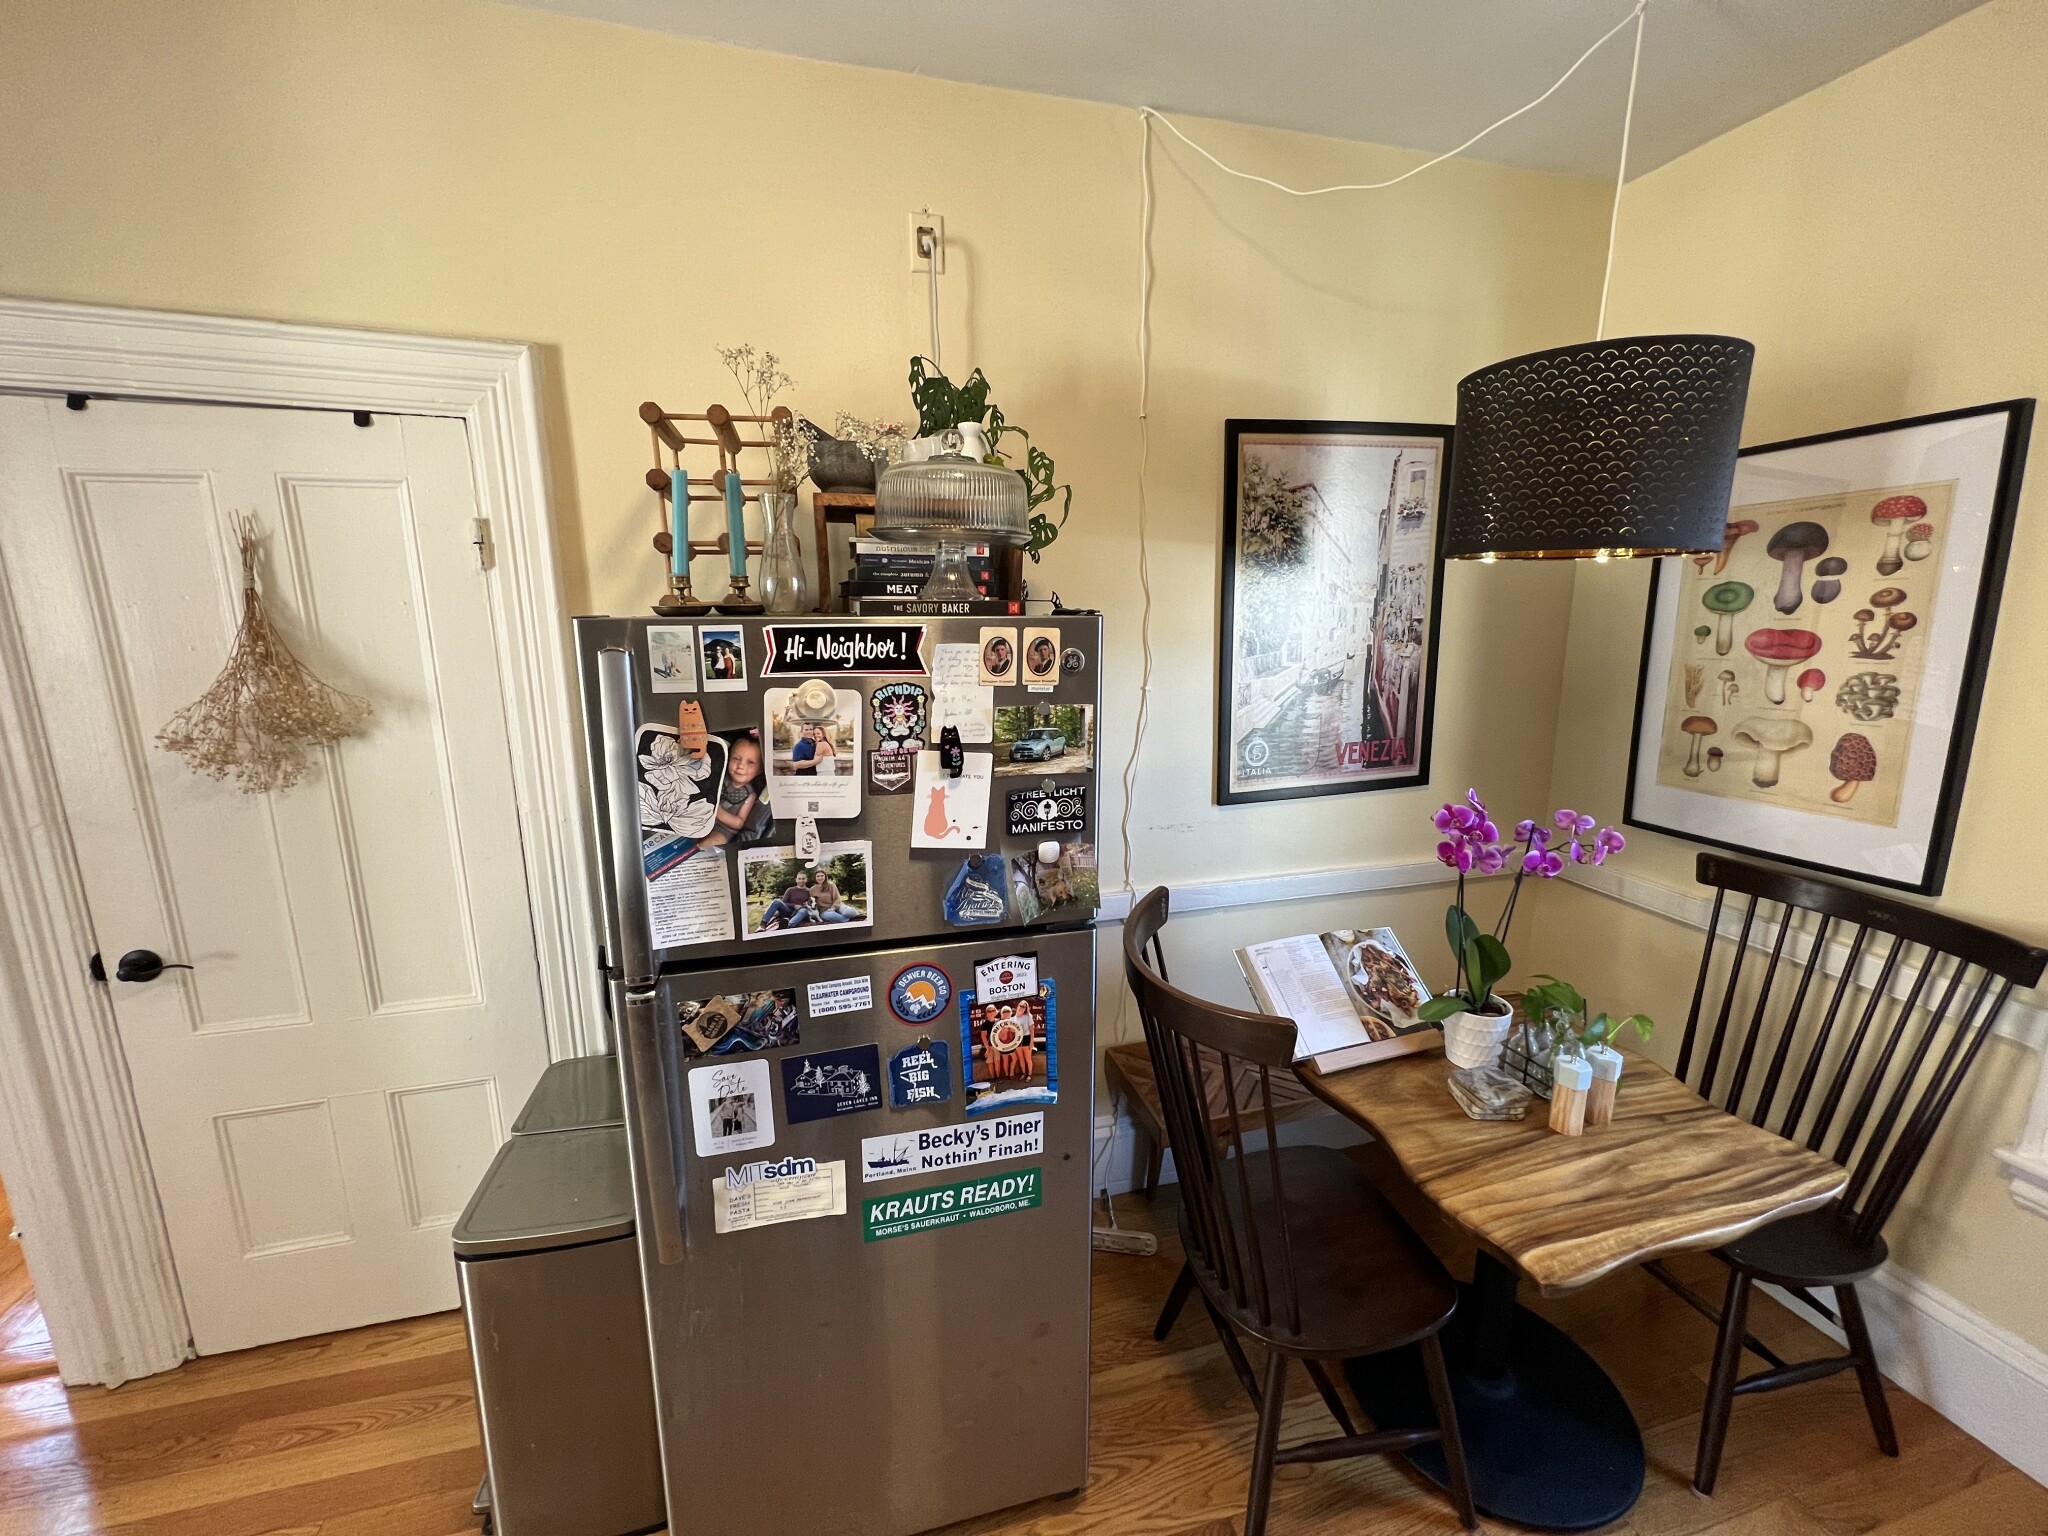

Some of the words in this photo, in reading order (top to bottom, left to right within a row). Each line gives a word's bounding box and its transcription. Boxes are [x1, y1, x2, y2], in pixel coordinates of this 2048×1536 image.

[886, 584, 919, 594] MEAT
[906, 603, 938, 614] SAVORY
[942, 603, 970, 614] BAKER
[875, 684, 923, 700] RIPNDIP
[1335, 738, 1408, 765] VENEZIA
[1241, 768, 1272, 777] ITALIA
[1012, 820, 1084, 834] MANIFESTO
[981, 961, 1031, 977] ENTERING
[899, 970, 926, 988] DENVER
[926, 971, 942, 986] BEER
[811, 990, 839, 1000] CLEARWATER
[840, 986, 869, 996] CAMPGROUND
[989, 983, 1026, 995] BOSTON
[819, 1006, 837, 1014] (800)
[839, 1001, 870, 1010] 595-7761
[902, 1051, 933, 1068] REEL
[712, 1070, 737, 1088] Save
[909, 1070, 930, 1081] BIG
[718, 1078, 747, 1098] Date
[907, 1086, 937, 1101] FISH
[918, 1125, 990, 1151] Becky's
[995, 1119, 1042, 1139] Diner
[921, 1147, 982, 1168] Nothin'
[988, 1139, 1038, 1158] Finah!
[864, 1169, 895, 1179] Portland,
[897, 1166, 917, 1174] Maine
[729, 1201, 750, 1209] FRESH
[870, 1190, 955, 1223] KRAUTS
[960, 1174, 1035, 1206] READY!
[875, 1224, 909, 1236] MORSE'S
[910, 1213, 960, 1230] SAUERKRAUT
[969, 1202, 1017, 1218] WALDOBORO,
[1018, 1200, 1031, 1208] ME.
